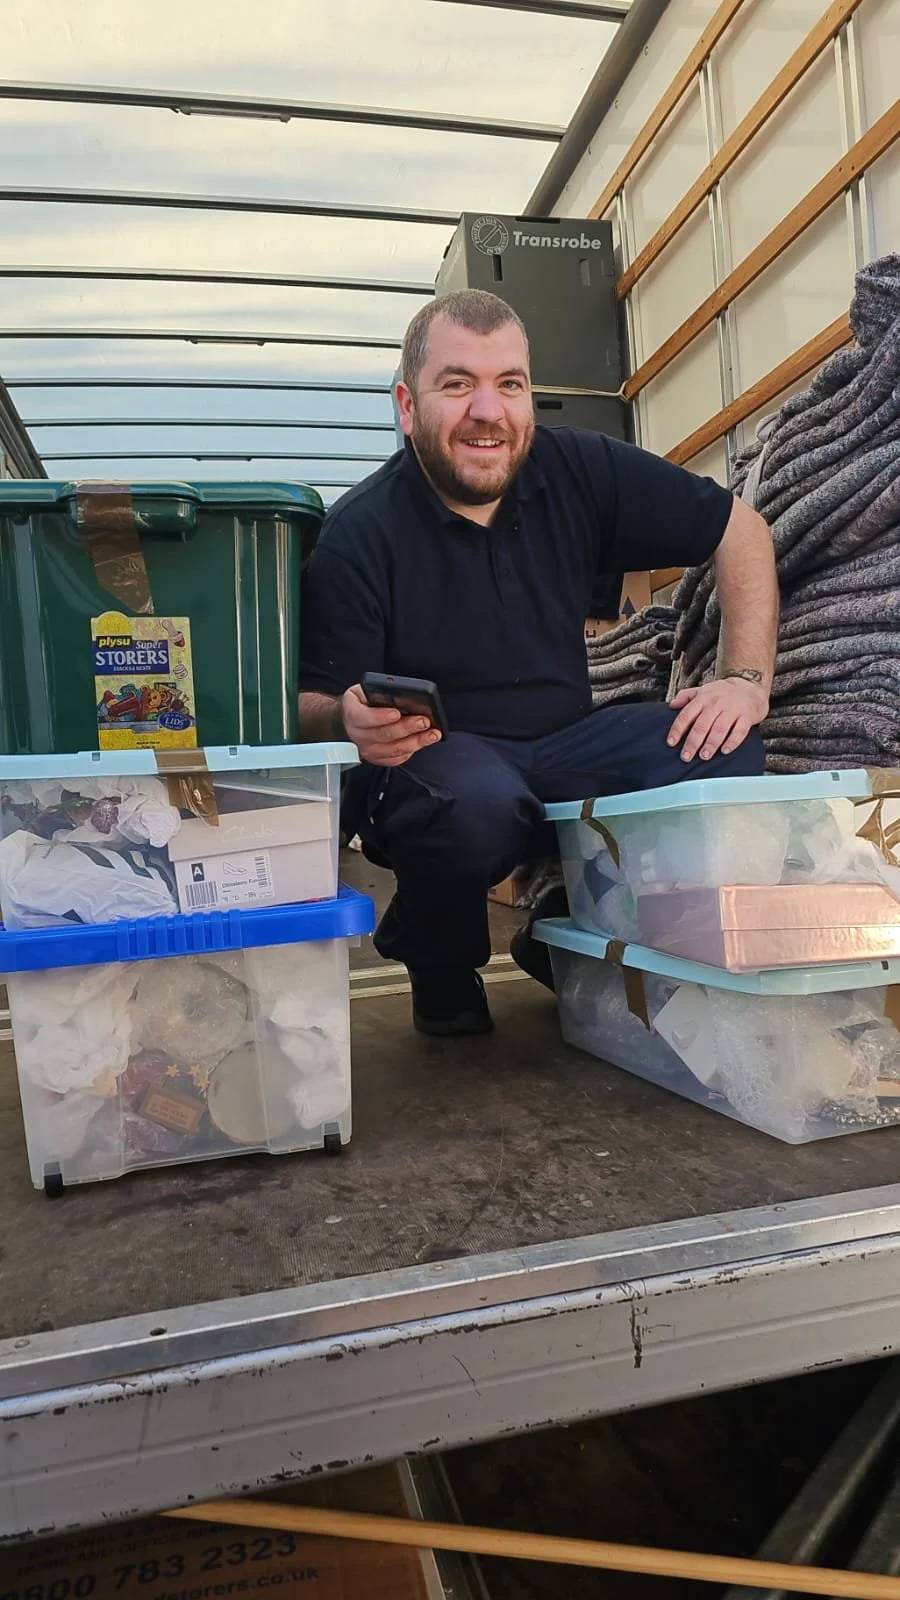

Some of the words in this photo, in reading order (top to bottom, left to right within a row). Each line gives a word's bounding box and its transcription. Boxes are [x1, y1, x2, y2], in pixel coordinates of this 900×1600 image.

[513, 231, 601, 250] Transrobe
[99, 637, 131, 648] plysu
[135, 640, 163, 650] Super
[95, 649, 168, 666] STORERS
[165, 717, 184, 726] LIDS
[193, 866, 203, 877] A
[113, 1553, 185, 1589] 783
[200, 1534, 298, 1573] 2323
